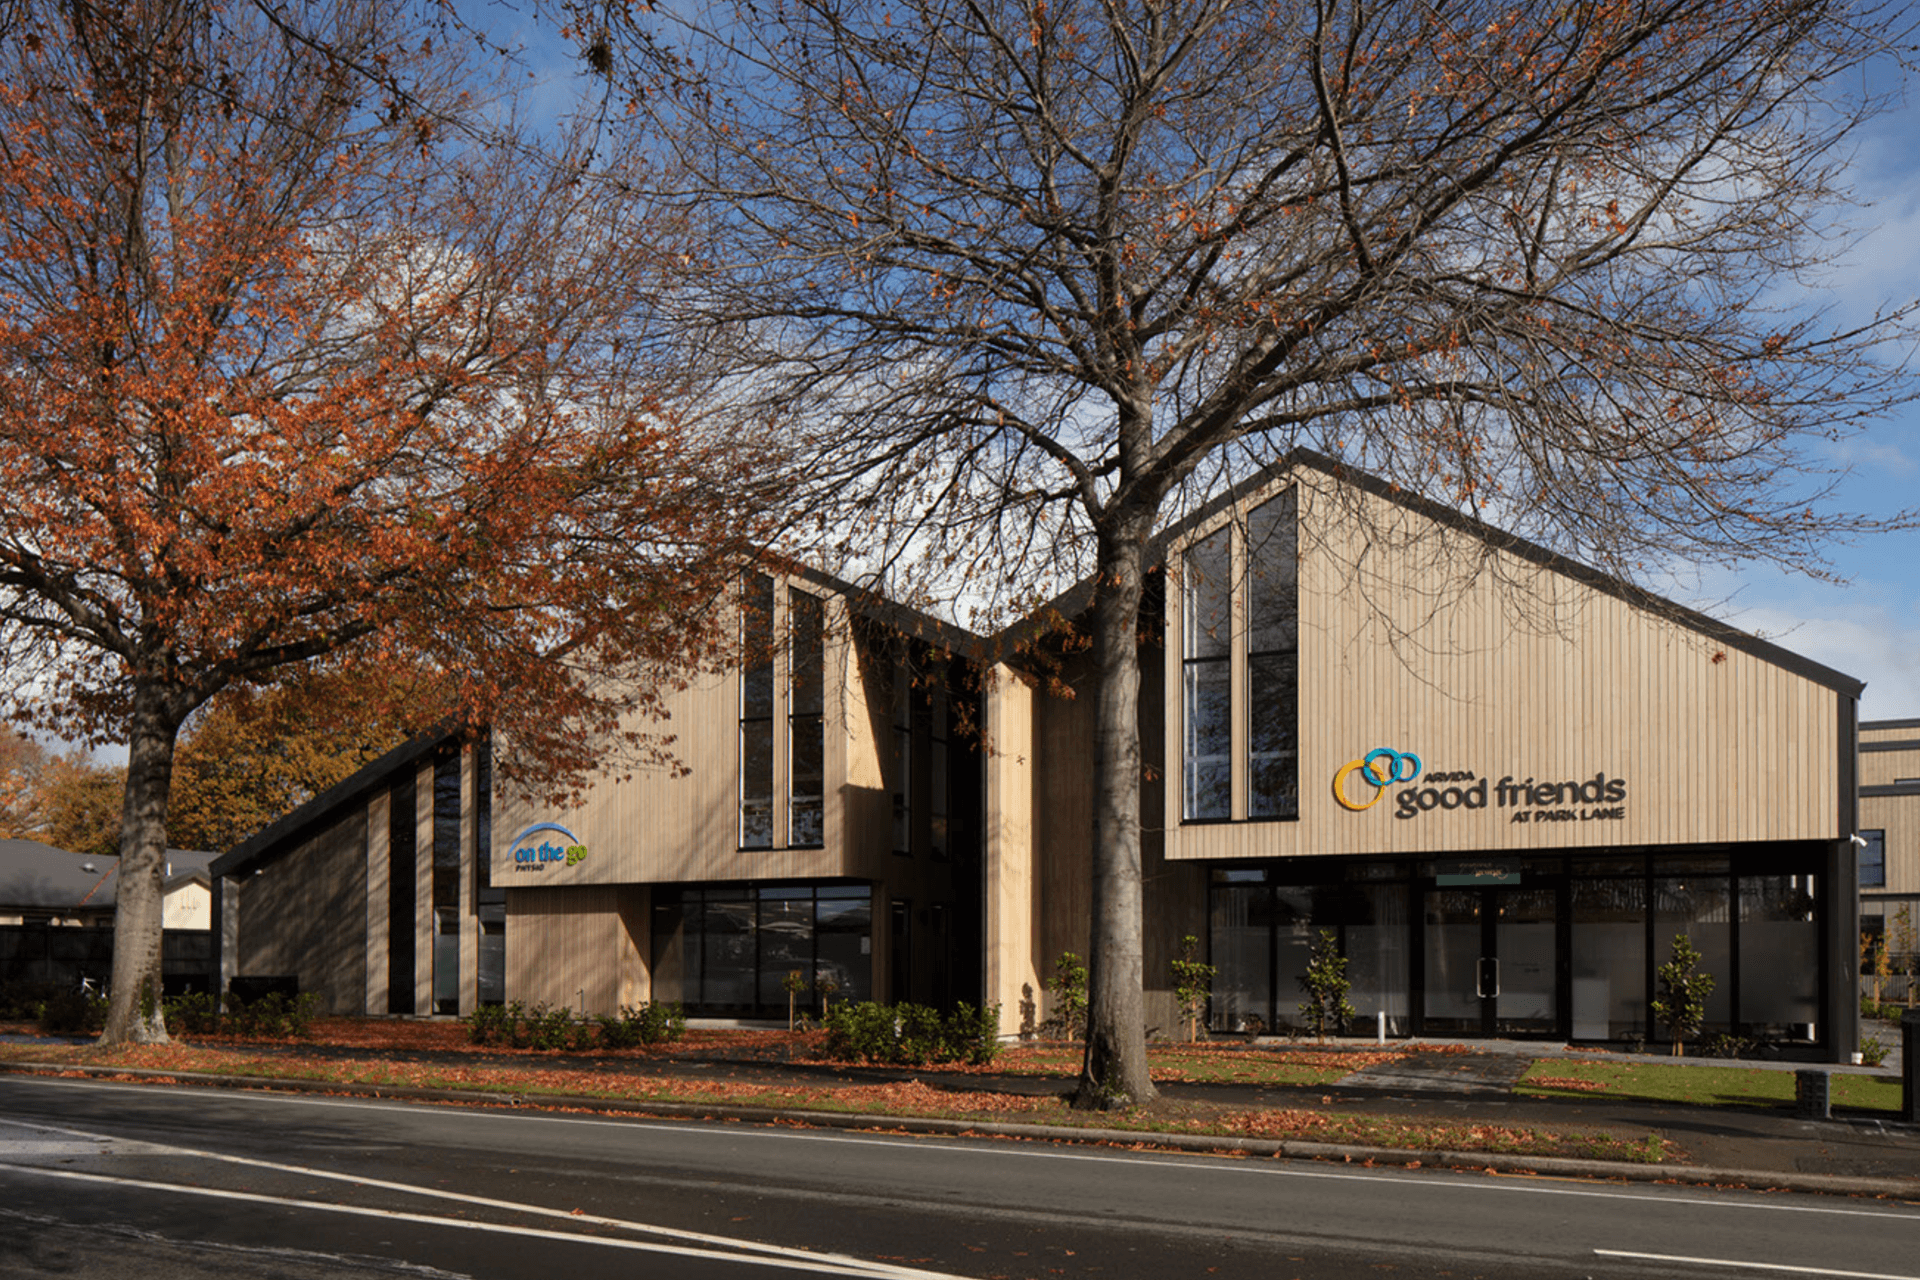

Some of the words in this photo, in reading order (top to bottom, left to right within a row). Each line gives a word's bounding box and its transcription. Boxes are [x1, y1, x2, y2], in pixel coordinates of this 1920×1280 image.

[1423, 770, 1475, 783] ARVIDA
[1395, 777, 1487, 819] good
[1494, 771, 1626, 807] friends
[1510, 811, 1532, 824] AT
[1534, 808, 1578, 823] PARK
[1580, 806, 1626, 821] LANE
[515, 848, 536, 863] on
[538, 841, 565, 862] the
[566, 845, 587, 866] go
